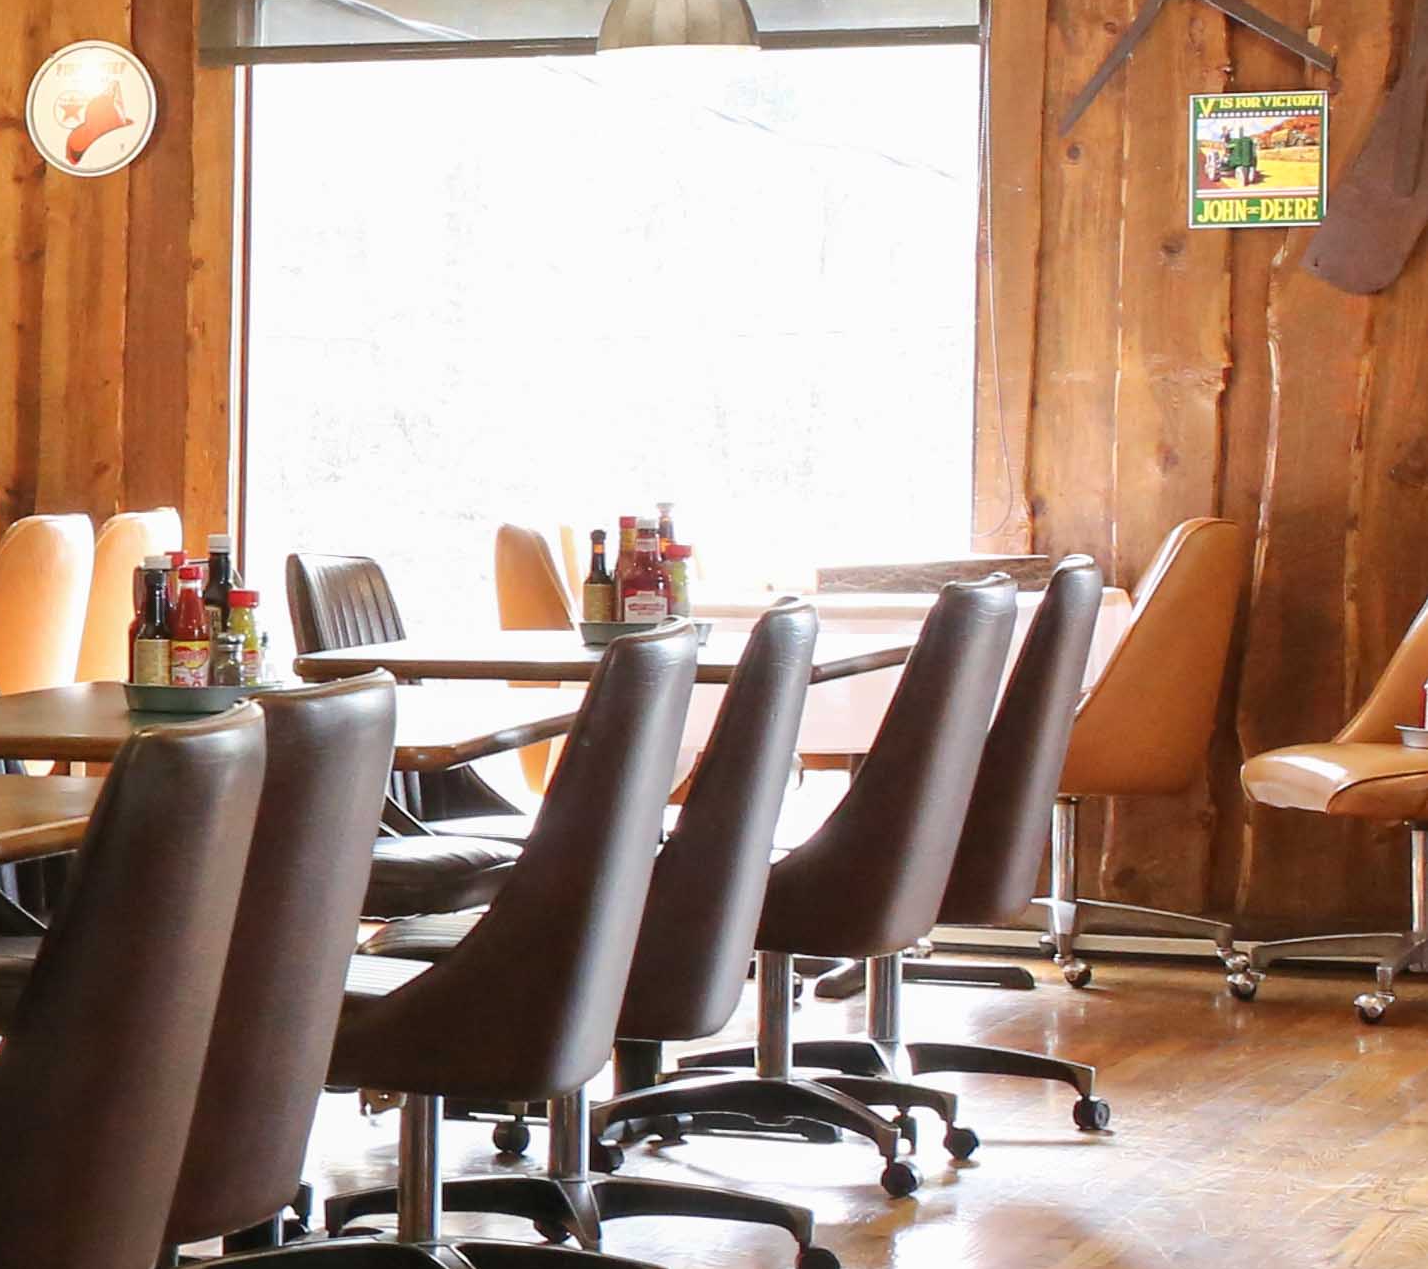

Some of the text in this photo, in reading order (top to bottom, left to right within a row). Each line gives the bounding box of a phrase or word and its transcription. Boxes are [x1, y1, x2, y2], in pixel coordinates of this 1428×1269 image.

[1197, 94, 1324, 118] V IS FOR VICTORY!
[1196, 197, 1319, 223] JOHN DEERE
